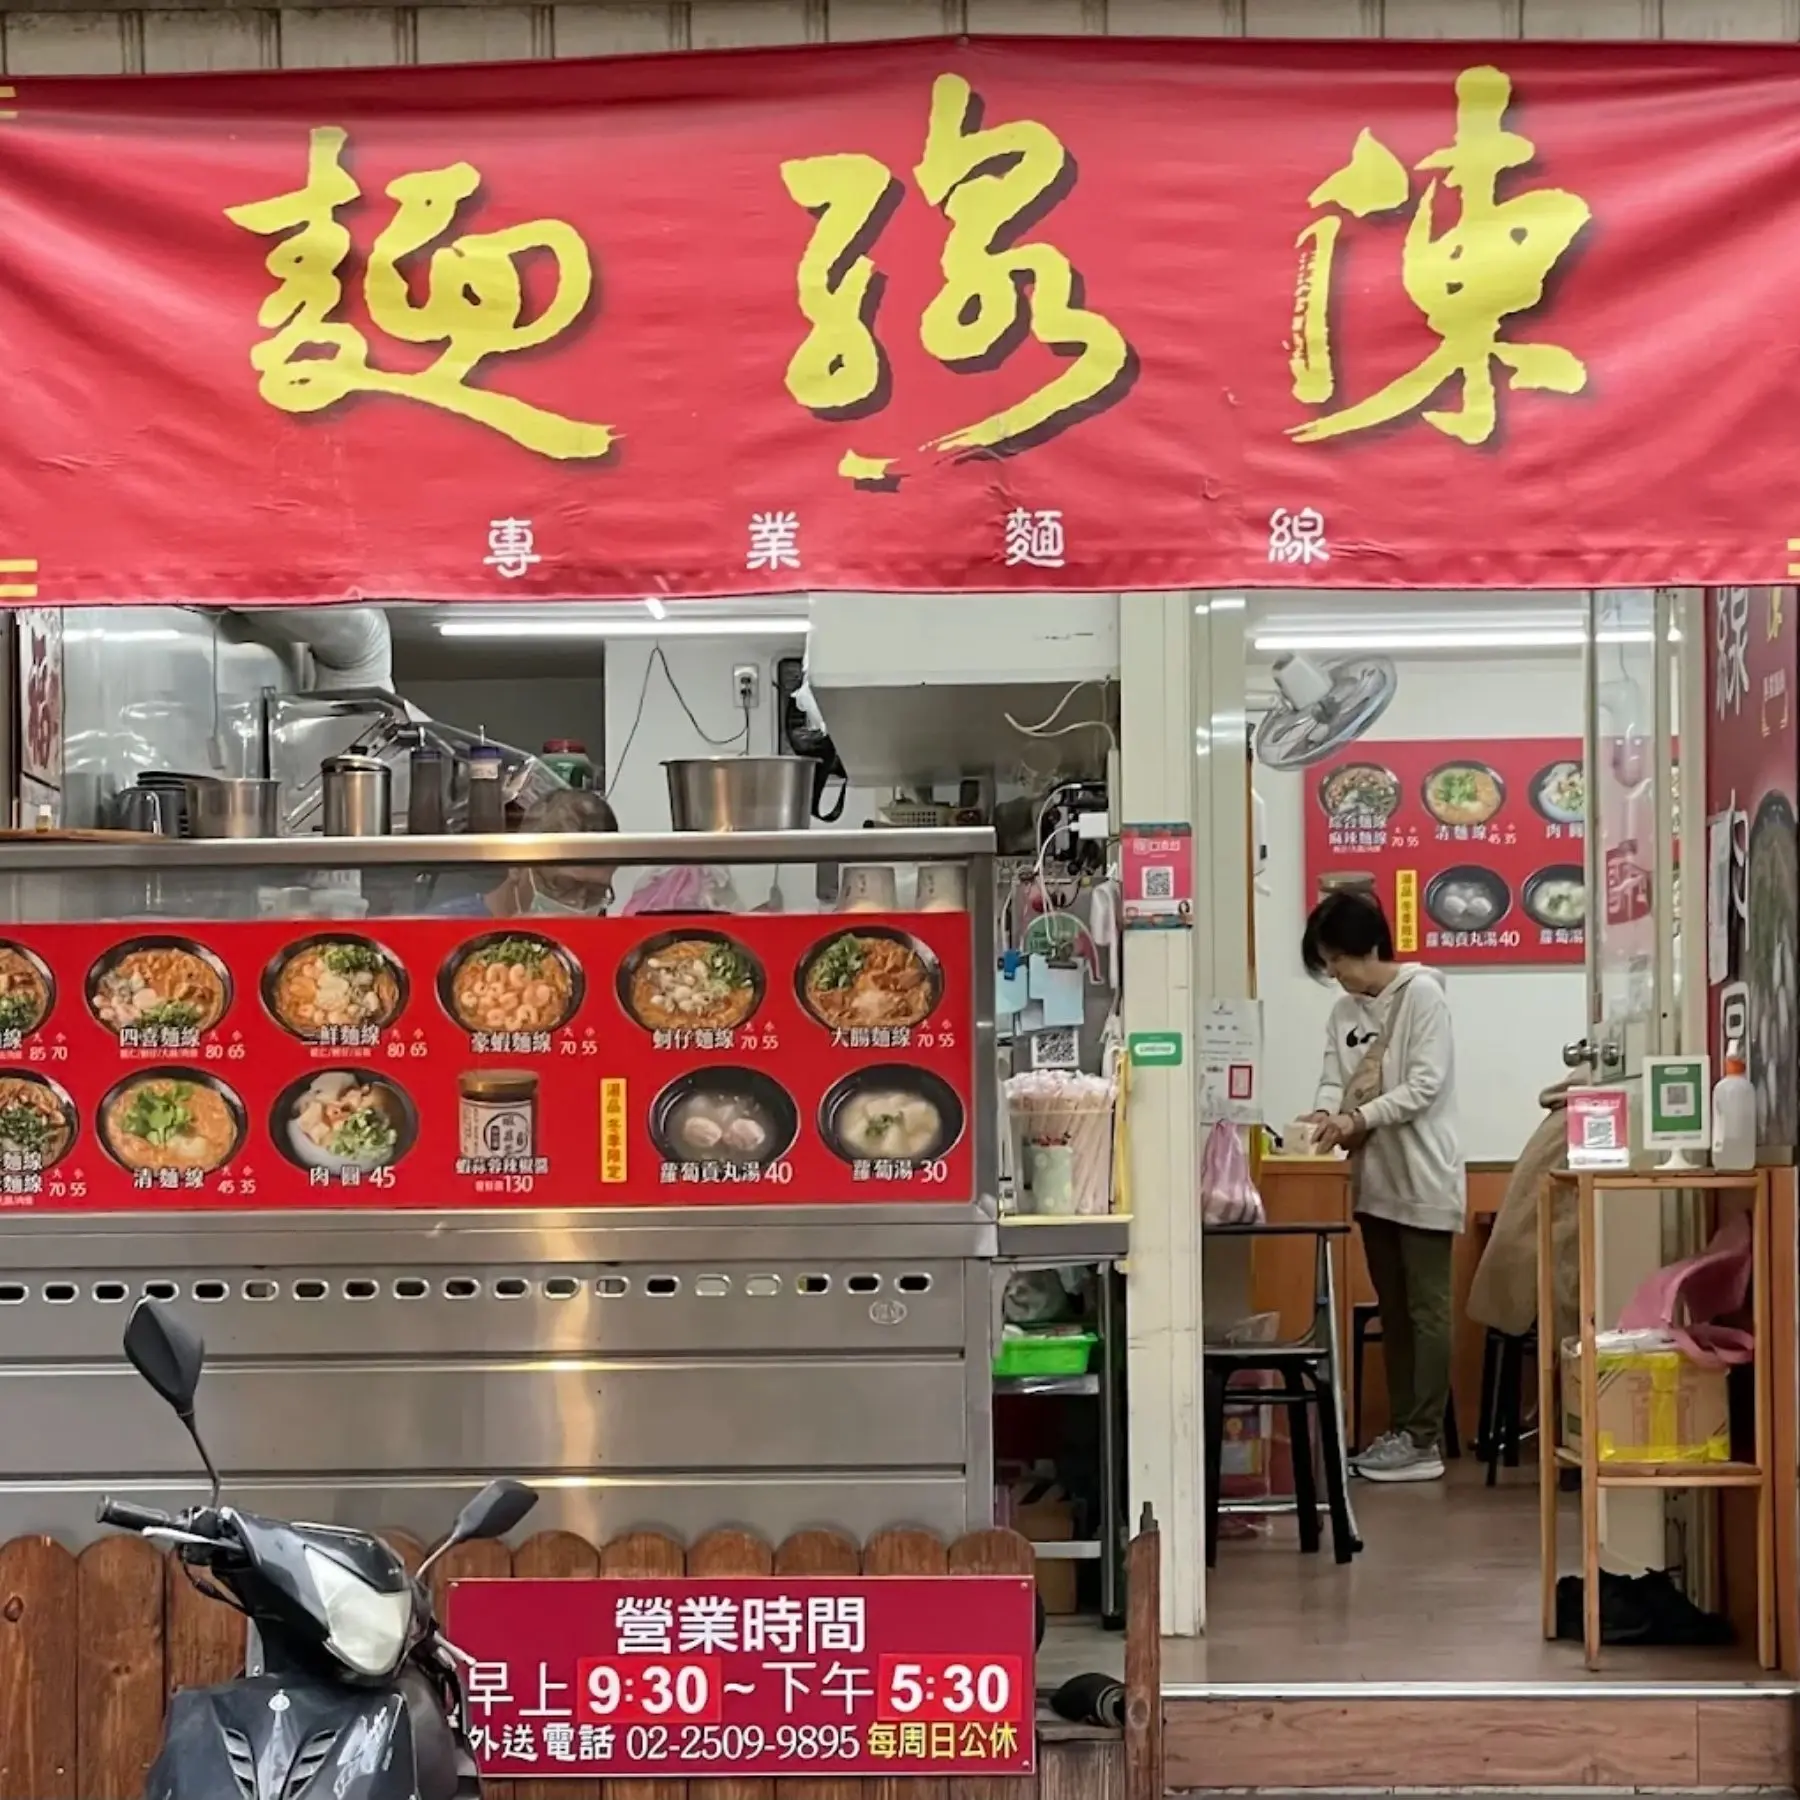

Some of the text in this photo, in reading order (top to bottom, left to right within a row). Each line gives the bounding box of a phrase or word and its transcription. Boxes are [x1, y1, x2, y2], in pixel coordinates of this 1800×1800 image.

[1391, 835, 1404, 847] 70
[1499, 930, 1521, 948] 40
[119, 1027, 245, 1060] 四喜麵線 80 65
[560, 1040, 576, 1055] 70
[581, 1040, 598, 1055] 55
[740, 1034, 758, 1050] 70
[761, 1034, 779, 1049] 55
[831, 1026, 954, 1048] 大腸麵線 70 55
[30, 1046, 46, 1061] 85
[51, 1046, 68, 1061] 70
[387, 1042, 405, 1058] 80
[410, 1042, 428, 1058] 65
[0, 1151, 42, 1171] 麵線
[851, 1160, 948, 1184] 蘿蔔湯 30
[133, 1168, 256, 1194] 清麵線 45 35
[369, 1167, 396, 1189] 45
[660, 1160, 793, 1185] 蘿蔔貢丸湯 40
[0, 1174, 87, 1198] 麵線 70 55
[503, 1175, 534, 1193] 130
[615, 1596, 866, 1655] 營業時間
[468, 1661, 573, 1717] 早上
[587, 1664, 710, 1716] 9:30
[762, 1661, 875, 1715] 下午
[889, 1663, 1010, 1713] 5:30
[468, 1722, 1019, 1762] 外送電話 02-2509-9895 每周日公休
